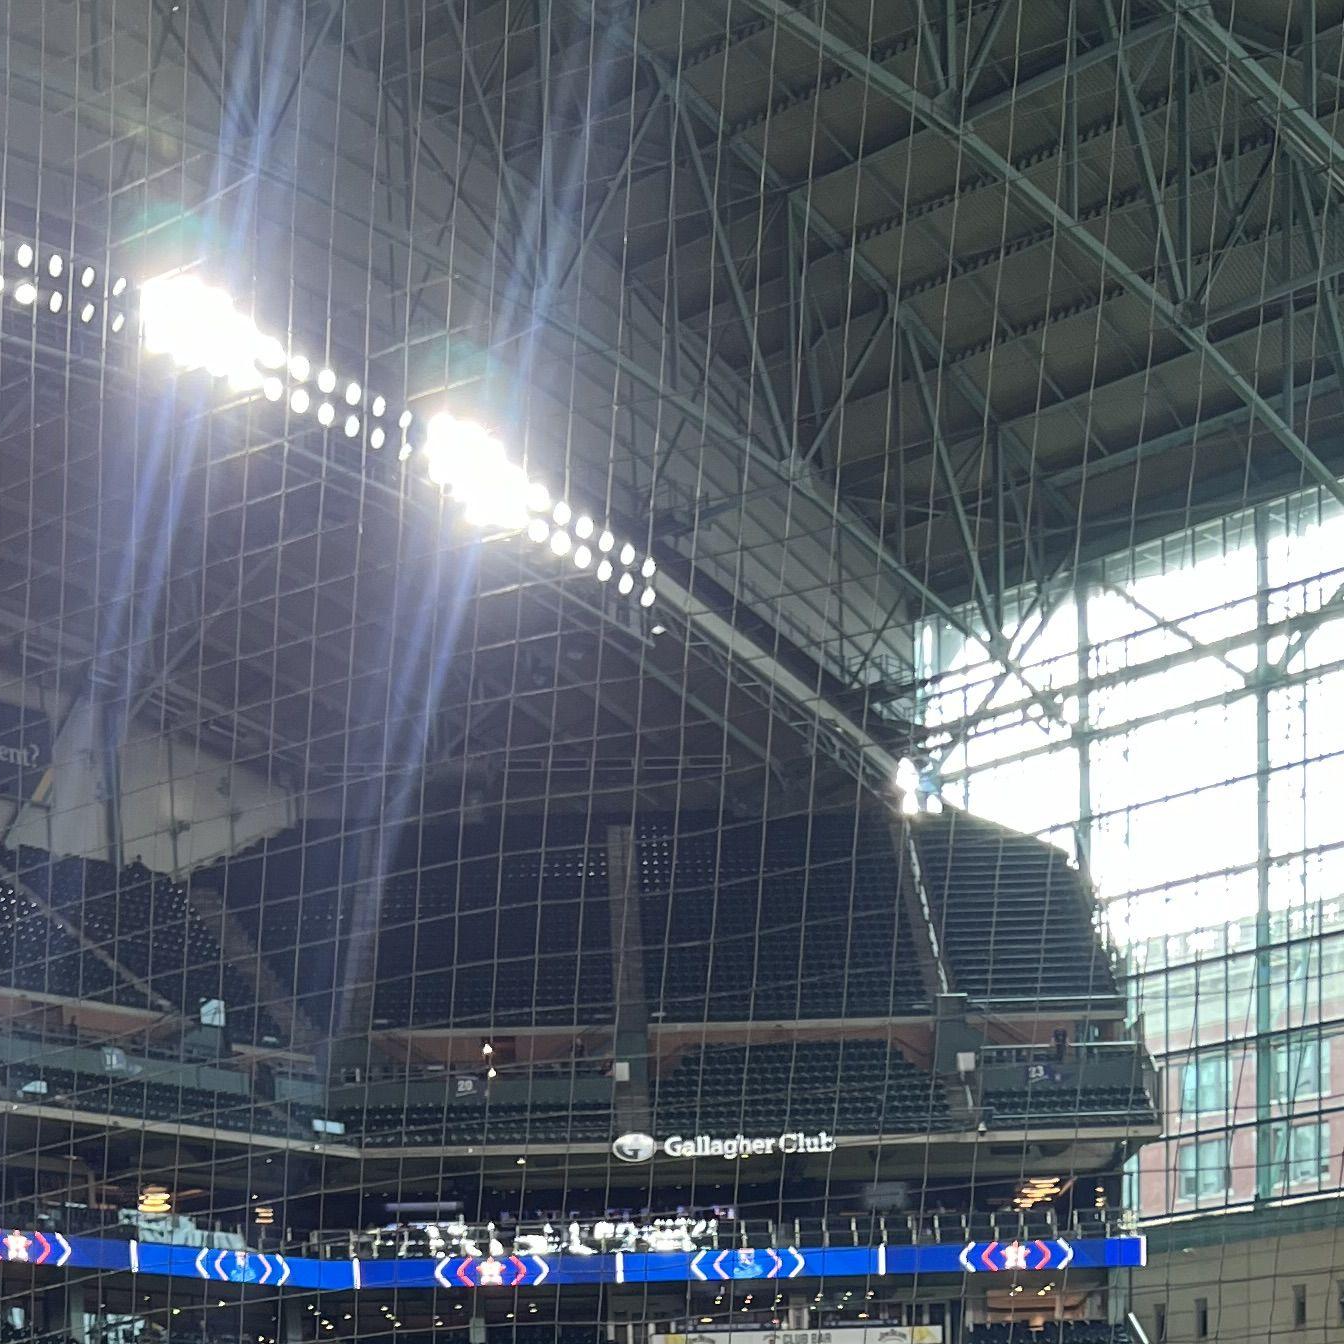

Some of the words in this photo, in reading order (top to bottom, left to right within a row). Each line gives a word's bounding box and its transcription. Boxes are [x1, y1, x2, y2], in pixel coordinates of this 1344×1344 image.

[664, 1133, 776, 1160] Gallagher
[778, 1131, 836, 1154] Club
[782, 1334, 808, 1344] CLUB
[810, 1332, 832, 1344] BAR
